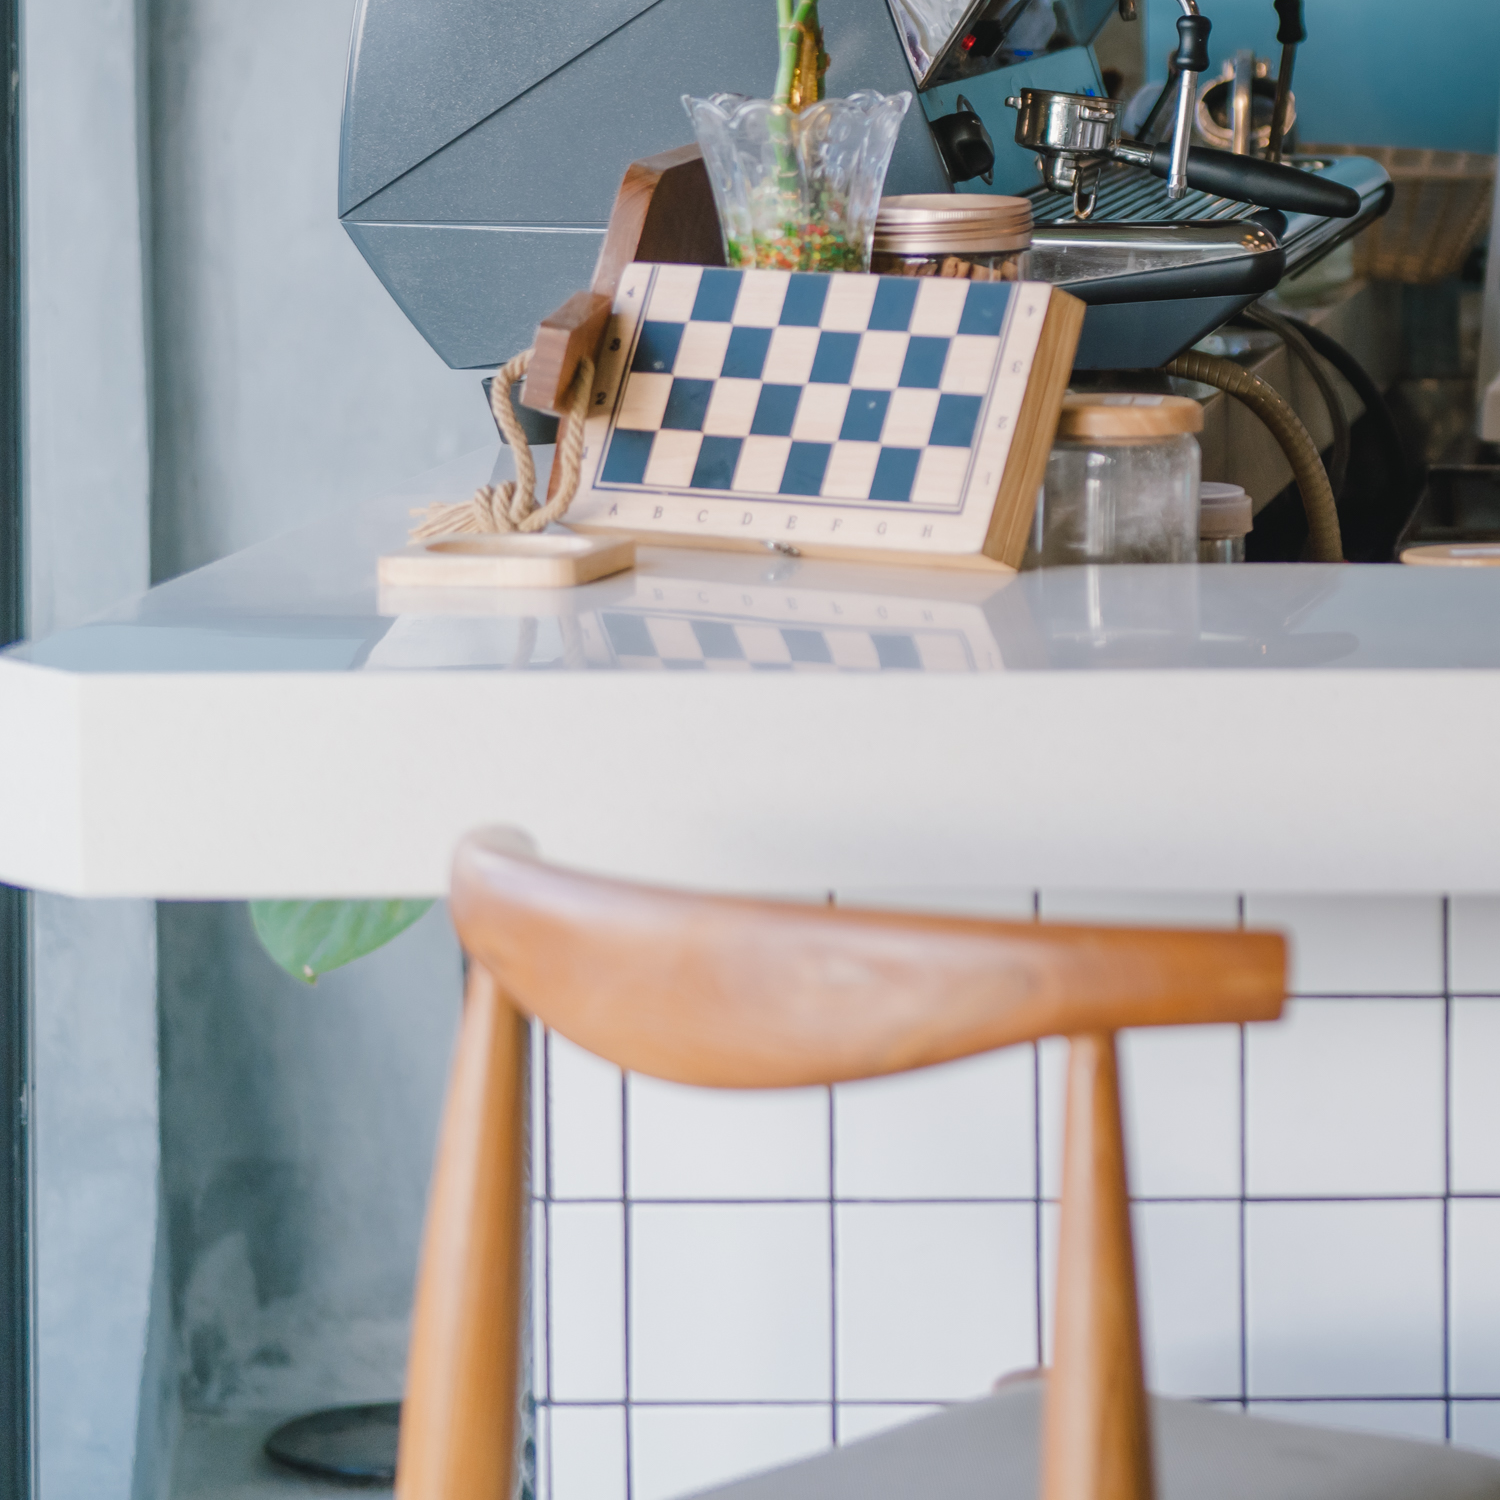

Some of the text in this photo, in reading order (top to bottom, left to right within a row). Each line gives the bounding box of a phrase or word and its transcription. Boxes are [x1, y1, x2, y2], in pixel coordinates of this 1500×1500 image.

[609, 503, 618, 516] A
[653, 506, 663, 519] B
[697, 509, 709, 523] C
[741, 512, 752, 525] D
[786, 515, 797, 529] E
[831, 518, 842, 532] F
[922, 525, 933, 538] H
